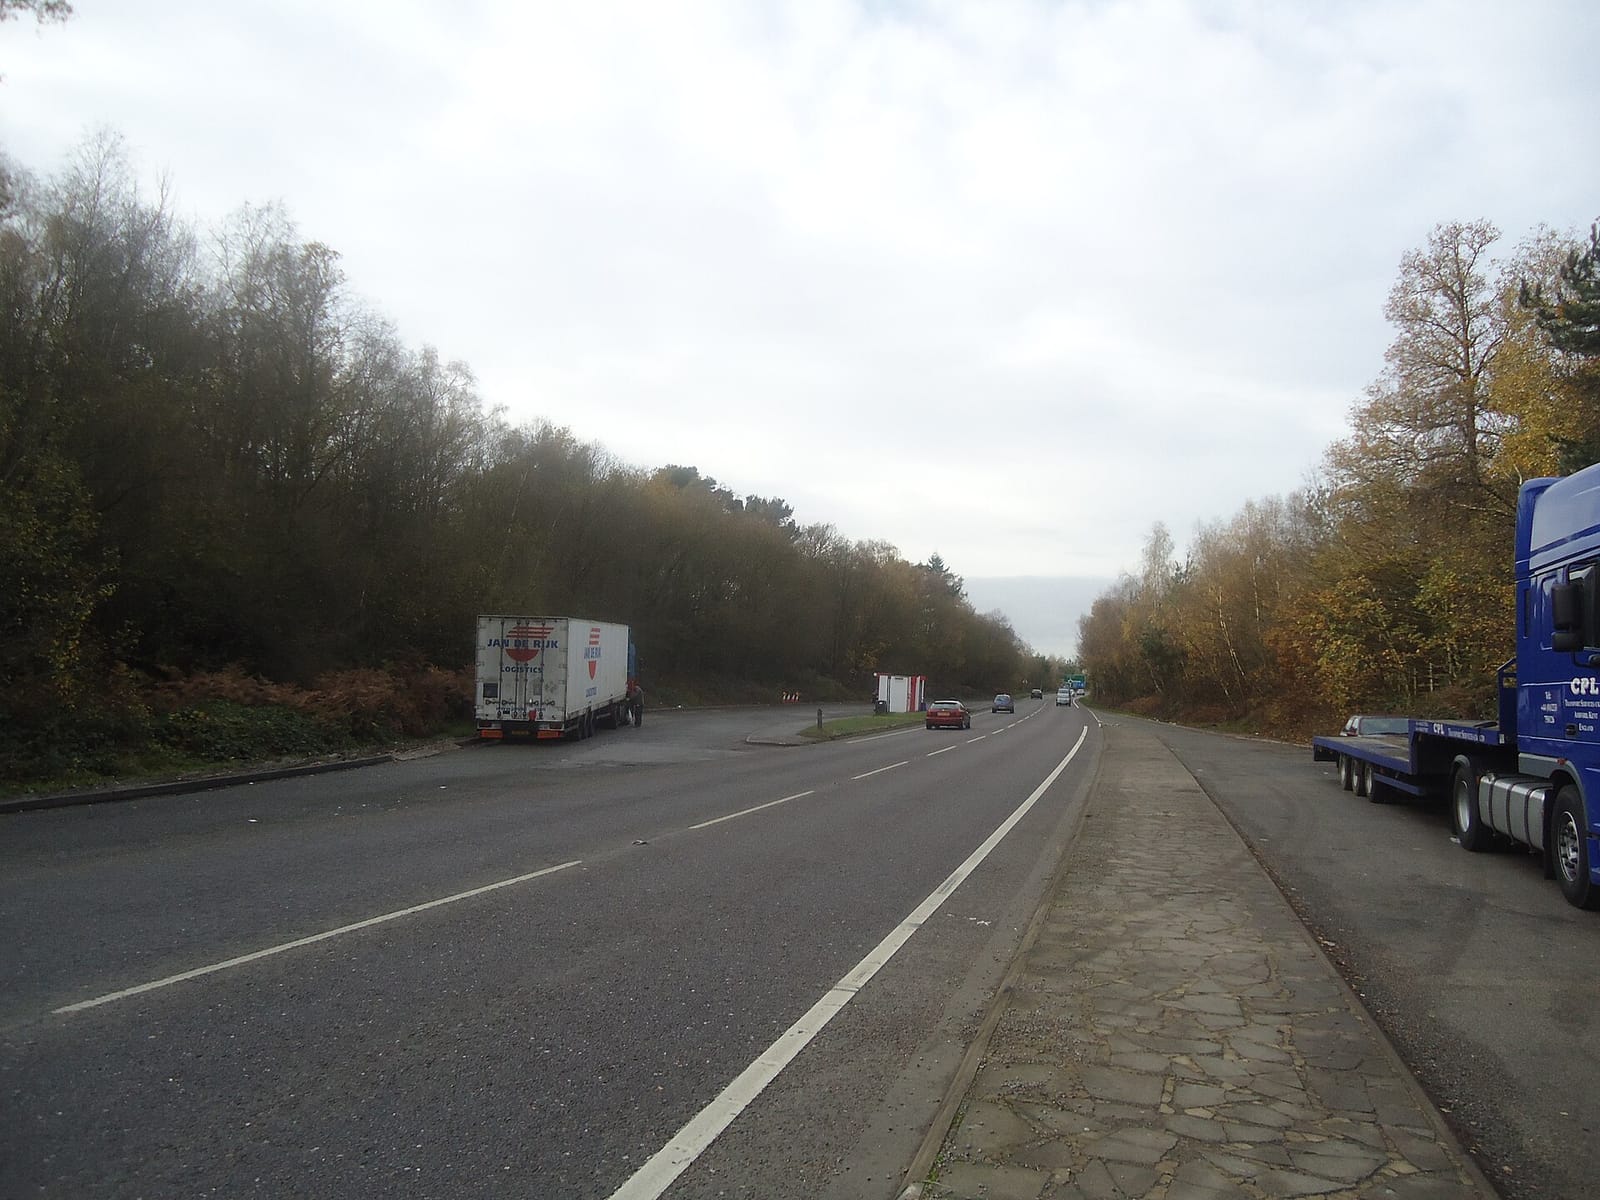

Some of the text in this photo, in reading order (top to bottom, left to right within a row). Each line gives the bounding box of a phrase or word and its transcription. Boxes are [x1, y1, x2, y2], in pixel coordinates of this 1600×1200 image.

[487, 639, 509, 648] JAN
[514, 640, 528, 648] DE
[1570, 677, 1599, 695] CPL
[1433, 723, 1445, 735] CPL
